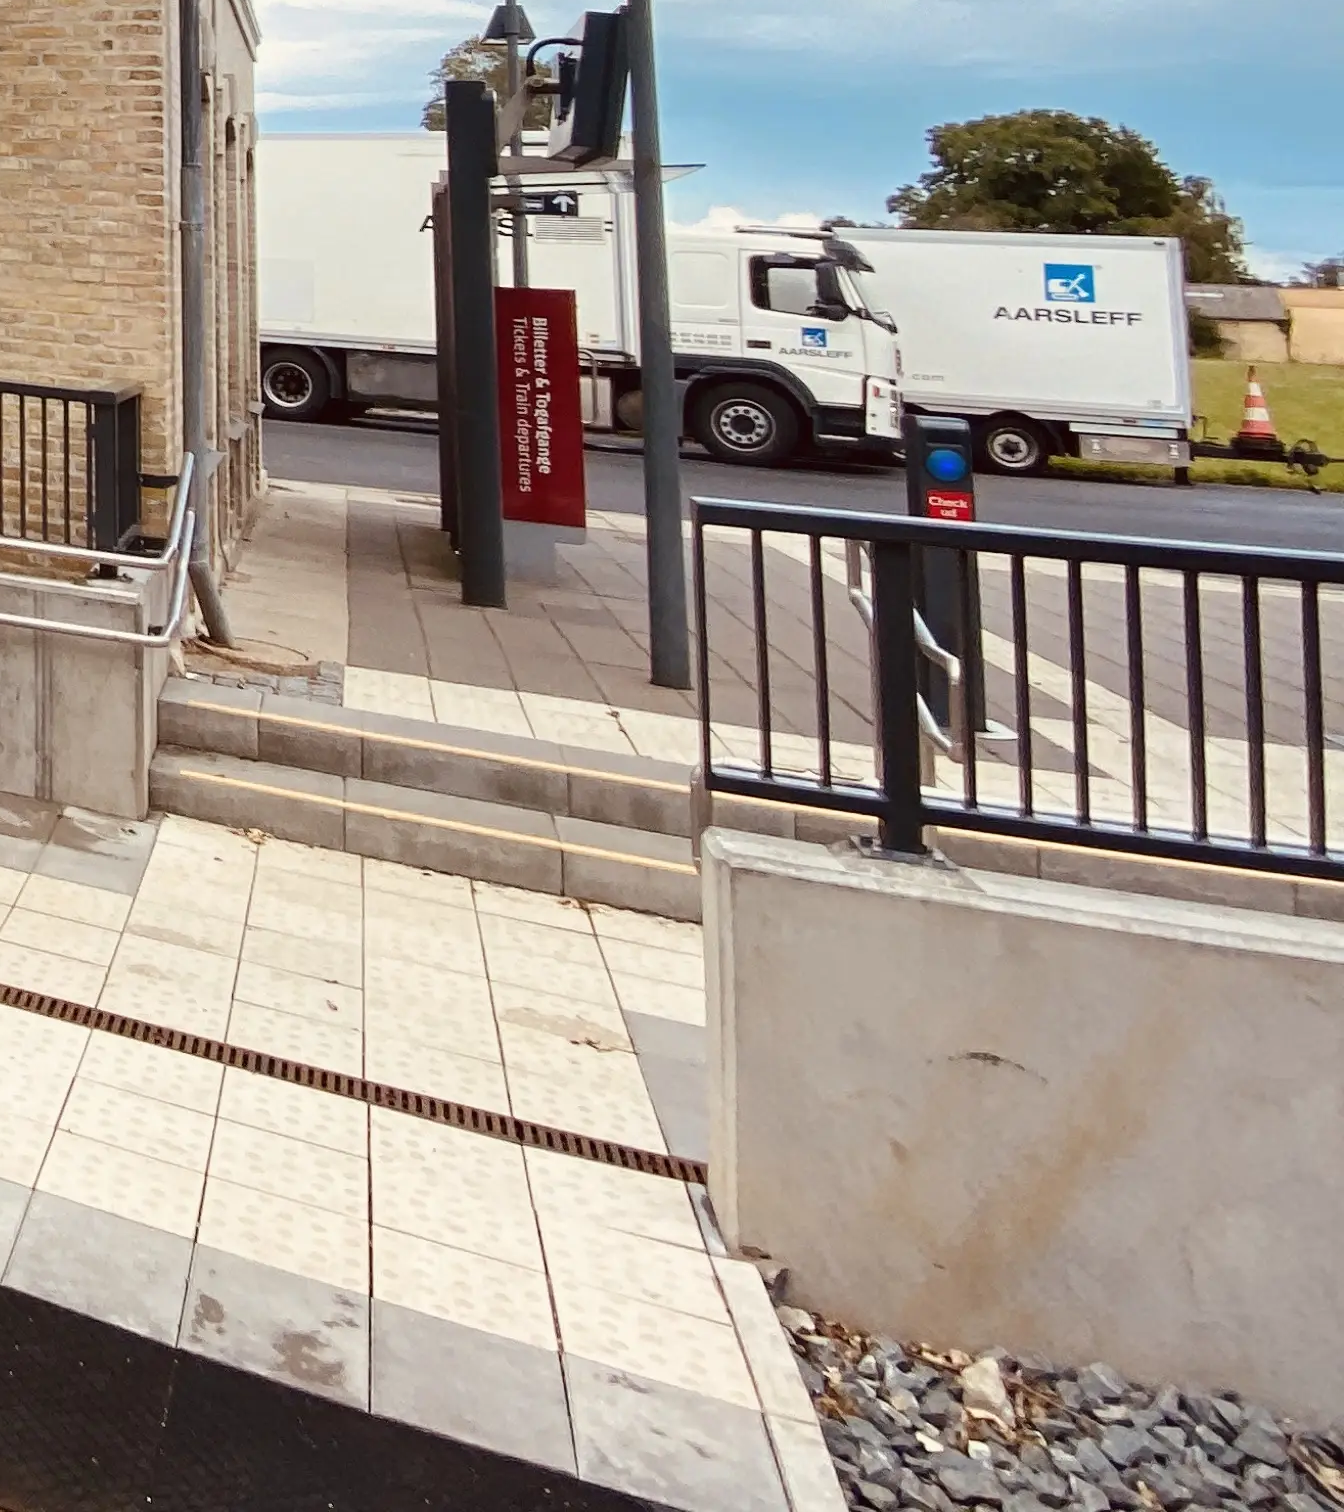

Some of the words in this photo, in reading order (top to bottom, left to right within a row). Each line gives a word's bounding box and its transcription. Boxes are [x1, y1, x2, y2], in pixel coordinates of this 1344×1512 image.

[993, 306, 1143, 326] AARSLEFF
[513, 317, 529, 364] Tickets
[532, 317, 549, 375] Billetter
[778, 347, 853, 359] AARSLEFF
[515, 368, 531, 378] &
[535, 377, 551, 388] &
[515, 383, 532, 415] Train
[533, 392, 553, 475] Togafgange
[514, 418, 533, 493] departures
